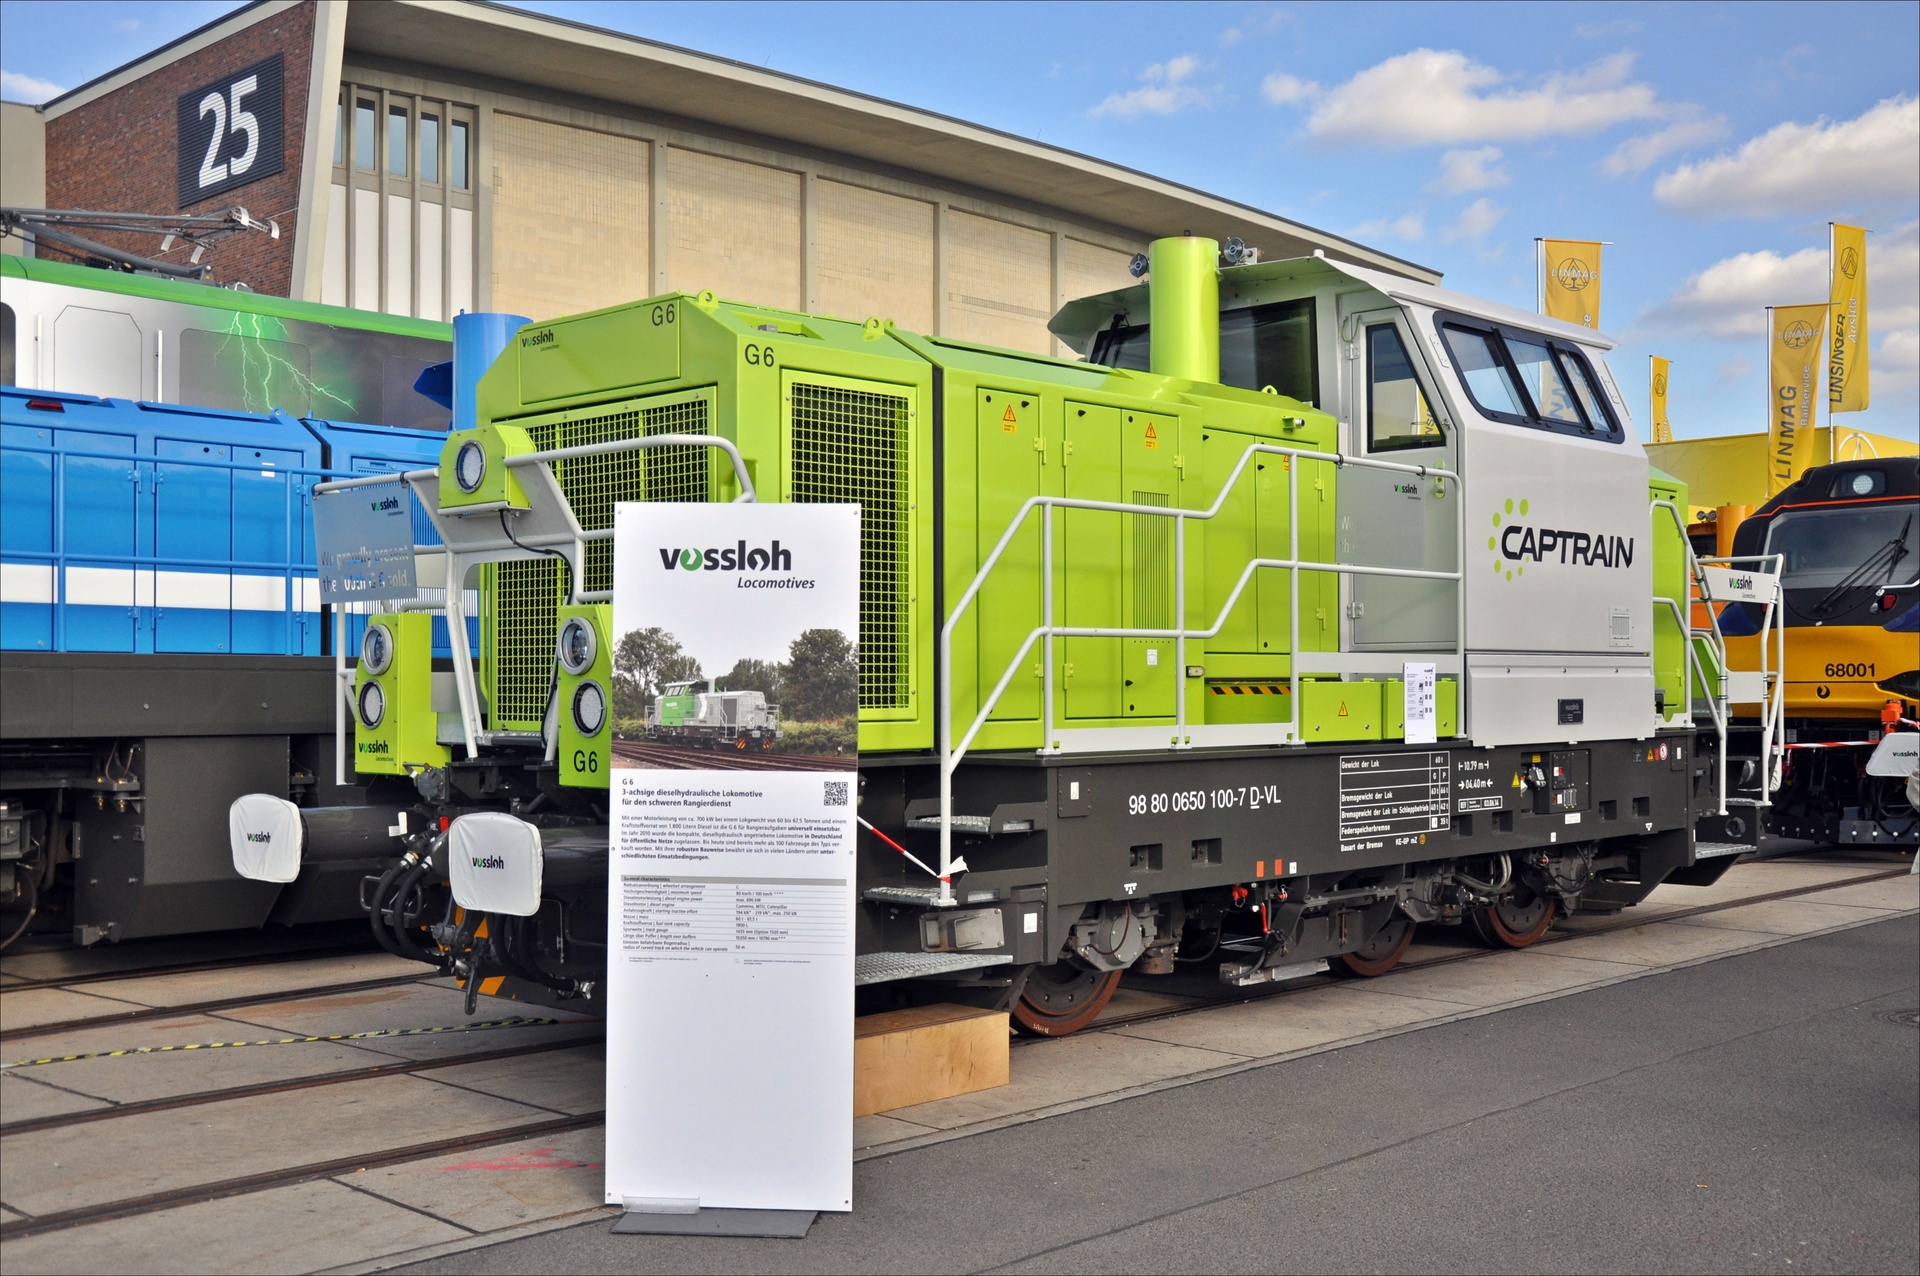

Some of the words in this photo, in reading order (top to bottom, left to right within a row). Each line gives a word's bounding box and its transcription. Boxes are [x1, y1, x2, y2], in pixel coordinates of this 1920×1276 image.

[198, 75, 259, 188] 25
[1551, 268, 1598, 280] LINMAG
[1846, 298, 1857, 344] Austria
[521, 329, 554, 348] vossloh
[1778, 328, 1820, 339] LINMAG
[1830, 314, 1845, 403] LINSINGER
[1800, 366, 1810, 427] Railservice
[1775, 385, 1797, 480] LINMAG
[1394, 484, 1417, 494] vossloh
[371, 496, 398, 511] vossloh
[1501, 525, 1634, 569] CAPTRAIN
[337, 546, 372, 570] proudly
[374, 545, 409, 565] present
[659, 540, 792, 571] vossloh
[323, 575, 337, 592] the
[737, 577, 815, 589] Locomotives
[1728, 574, 1753, 591] vossloh
[1825, 663, 1876, 678] 68001
[358, 740, 389, 755] vossloh
[1342, 761, 1360, 769] Gewicht
[1464, 761, 1477, 770] 10.79
[1466, 779, 1480, 789] 04.40
[622, 788, 655, 797] 3-achsige
[656, 789, 721, 798] dieselhydraulische
[1129, 794, 1147, 815] 98
[1150, 793, 1168, 813] 80
[1172, 791, 1206, 812] 0650
[1210, 788, 1247, 809] 100-7
[1250, 785, 1281, 809] D-VL
[1342, 793, 1373, 803] Bremsgewicht
[683, 799, 732, 808] Rangierdienst
[1342, 809, 1373, 819] Bremsgewicht
[1399, 804, 1429, 814] Schleppbetrieb
[247, 831, 271, 844] vossloh
[1341, 825, 1391, 835] Federspeicherbremse
[1341, 843, 1356, 852] Bauart
[472, 856, 505, 870] vossloh
